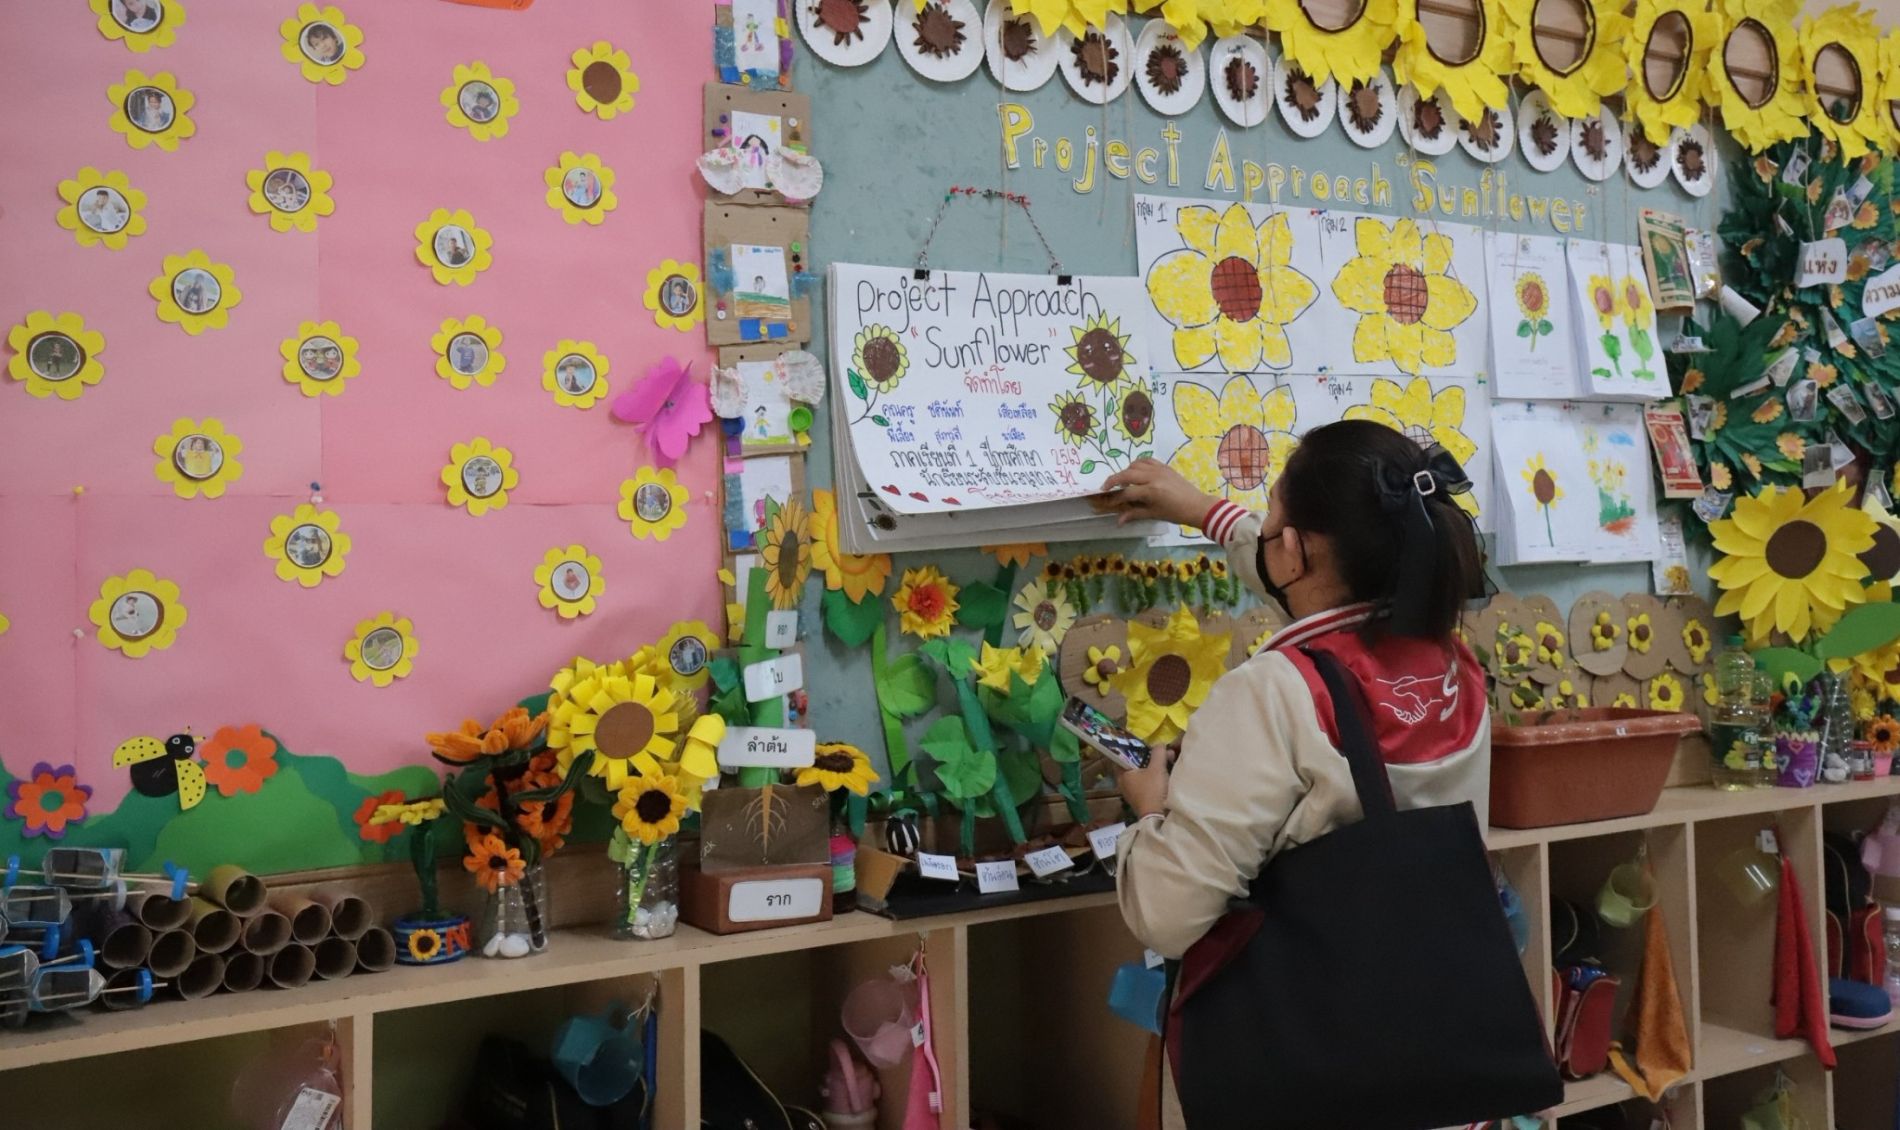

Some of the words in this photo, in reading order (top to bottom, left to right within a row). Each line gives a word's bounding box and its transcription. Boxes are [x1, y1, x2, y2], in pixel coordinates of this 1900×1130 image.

[997, 103, 1181, 193] Project
[1205, 125, 1391, 208] Approach
[1157, 202, 1168, 223] 1
[1338, 217, 1348, 233] 2
[1802, 252, 1838, 275] แห่ง
[972, 272, 1101, 337] Approach
[963, 364, 1022, 395] จัดทำโดย
[1344, 381, 1354, 395] 4
[770, 667, 784, 684] ใบ
[747, 735, 788, 754] ลำต้น
[766, 893, 791, 907] ราก
